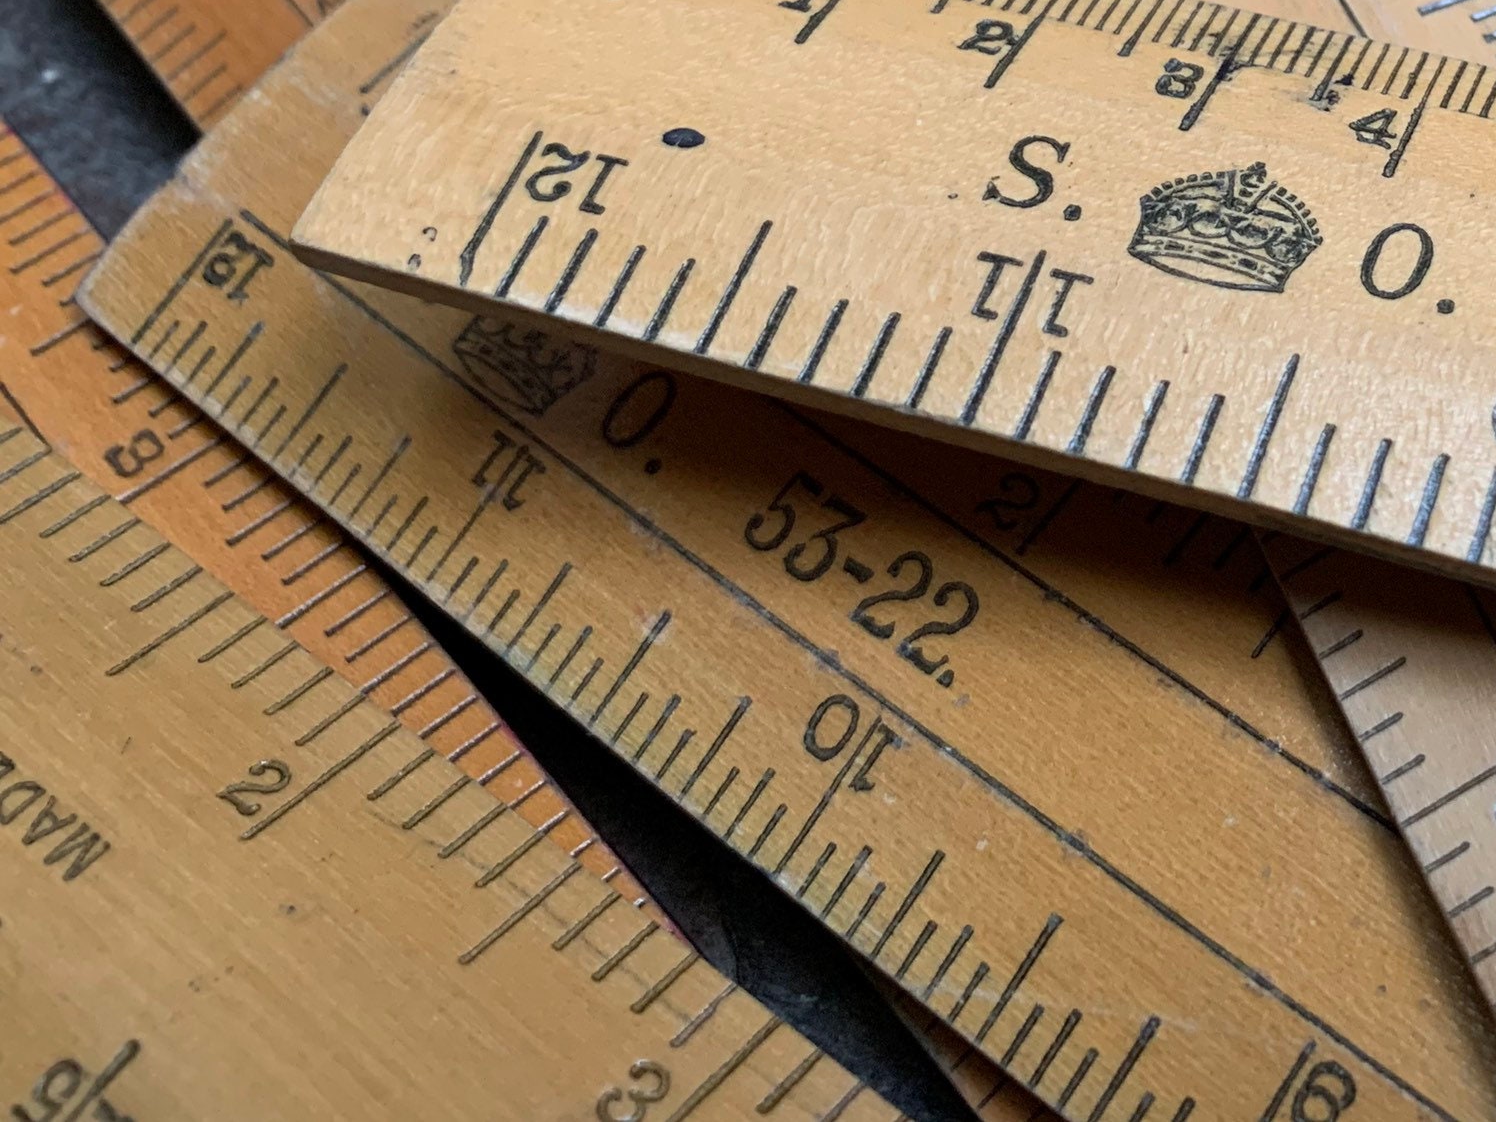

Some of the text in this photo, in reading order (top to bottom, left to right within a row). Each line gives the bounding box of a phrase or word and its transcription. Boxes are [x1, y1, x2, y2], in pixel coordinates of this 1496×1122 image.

[957, 19, 1020, 55] 2
[1155, 58, 1204, 99] 3
[1348, 108, 1397, 149] 4
[525, 141, 628, 215] 12
[982, 135, 1083, 222] S.
[1360, 222, 1455, 315] O.
[970, 251, 1094, 337] 11
[105, 429, 165, 478] 3
[604, 370, 980, 689] O. 53-22.
[804, 693, 900, 792] 10
[216, 759, 292, 816] 2
[596, 1059, 672, 1122] 3
